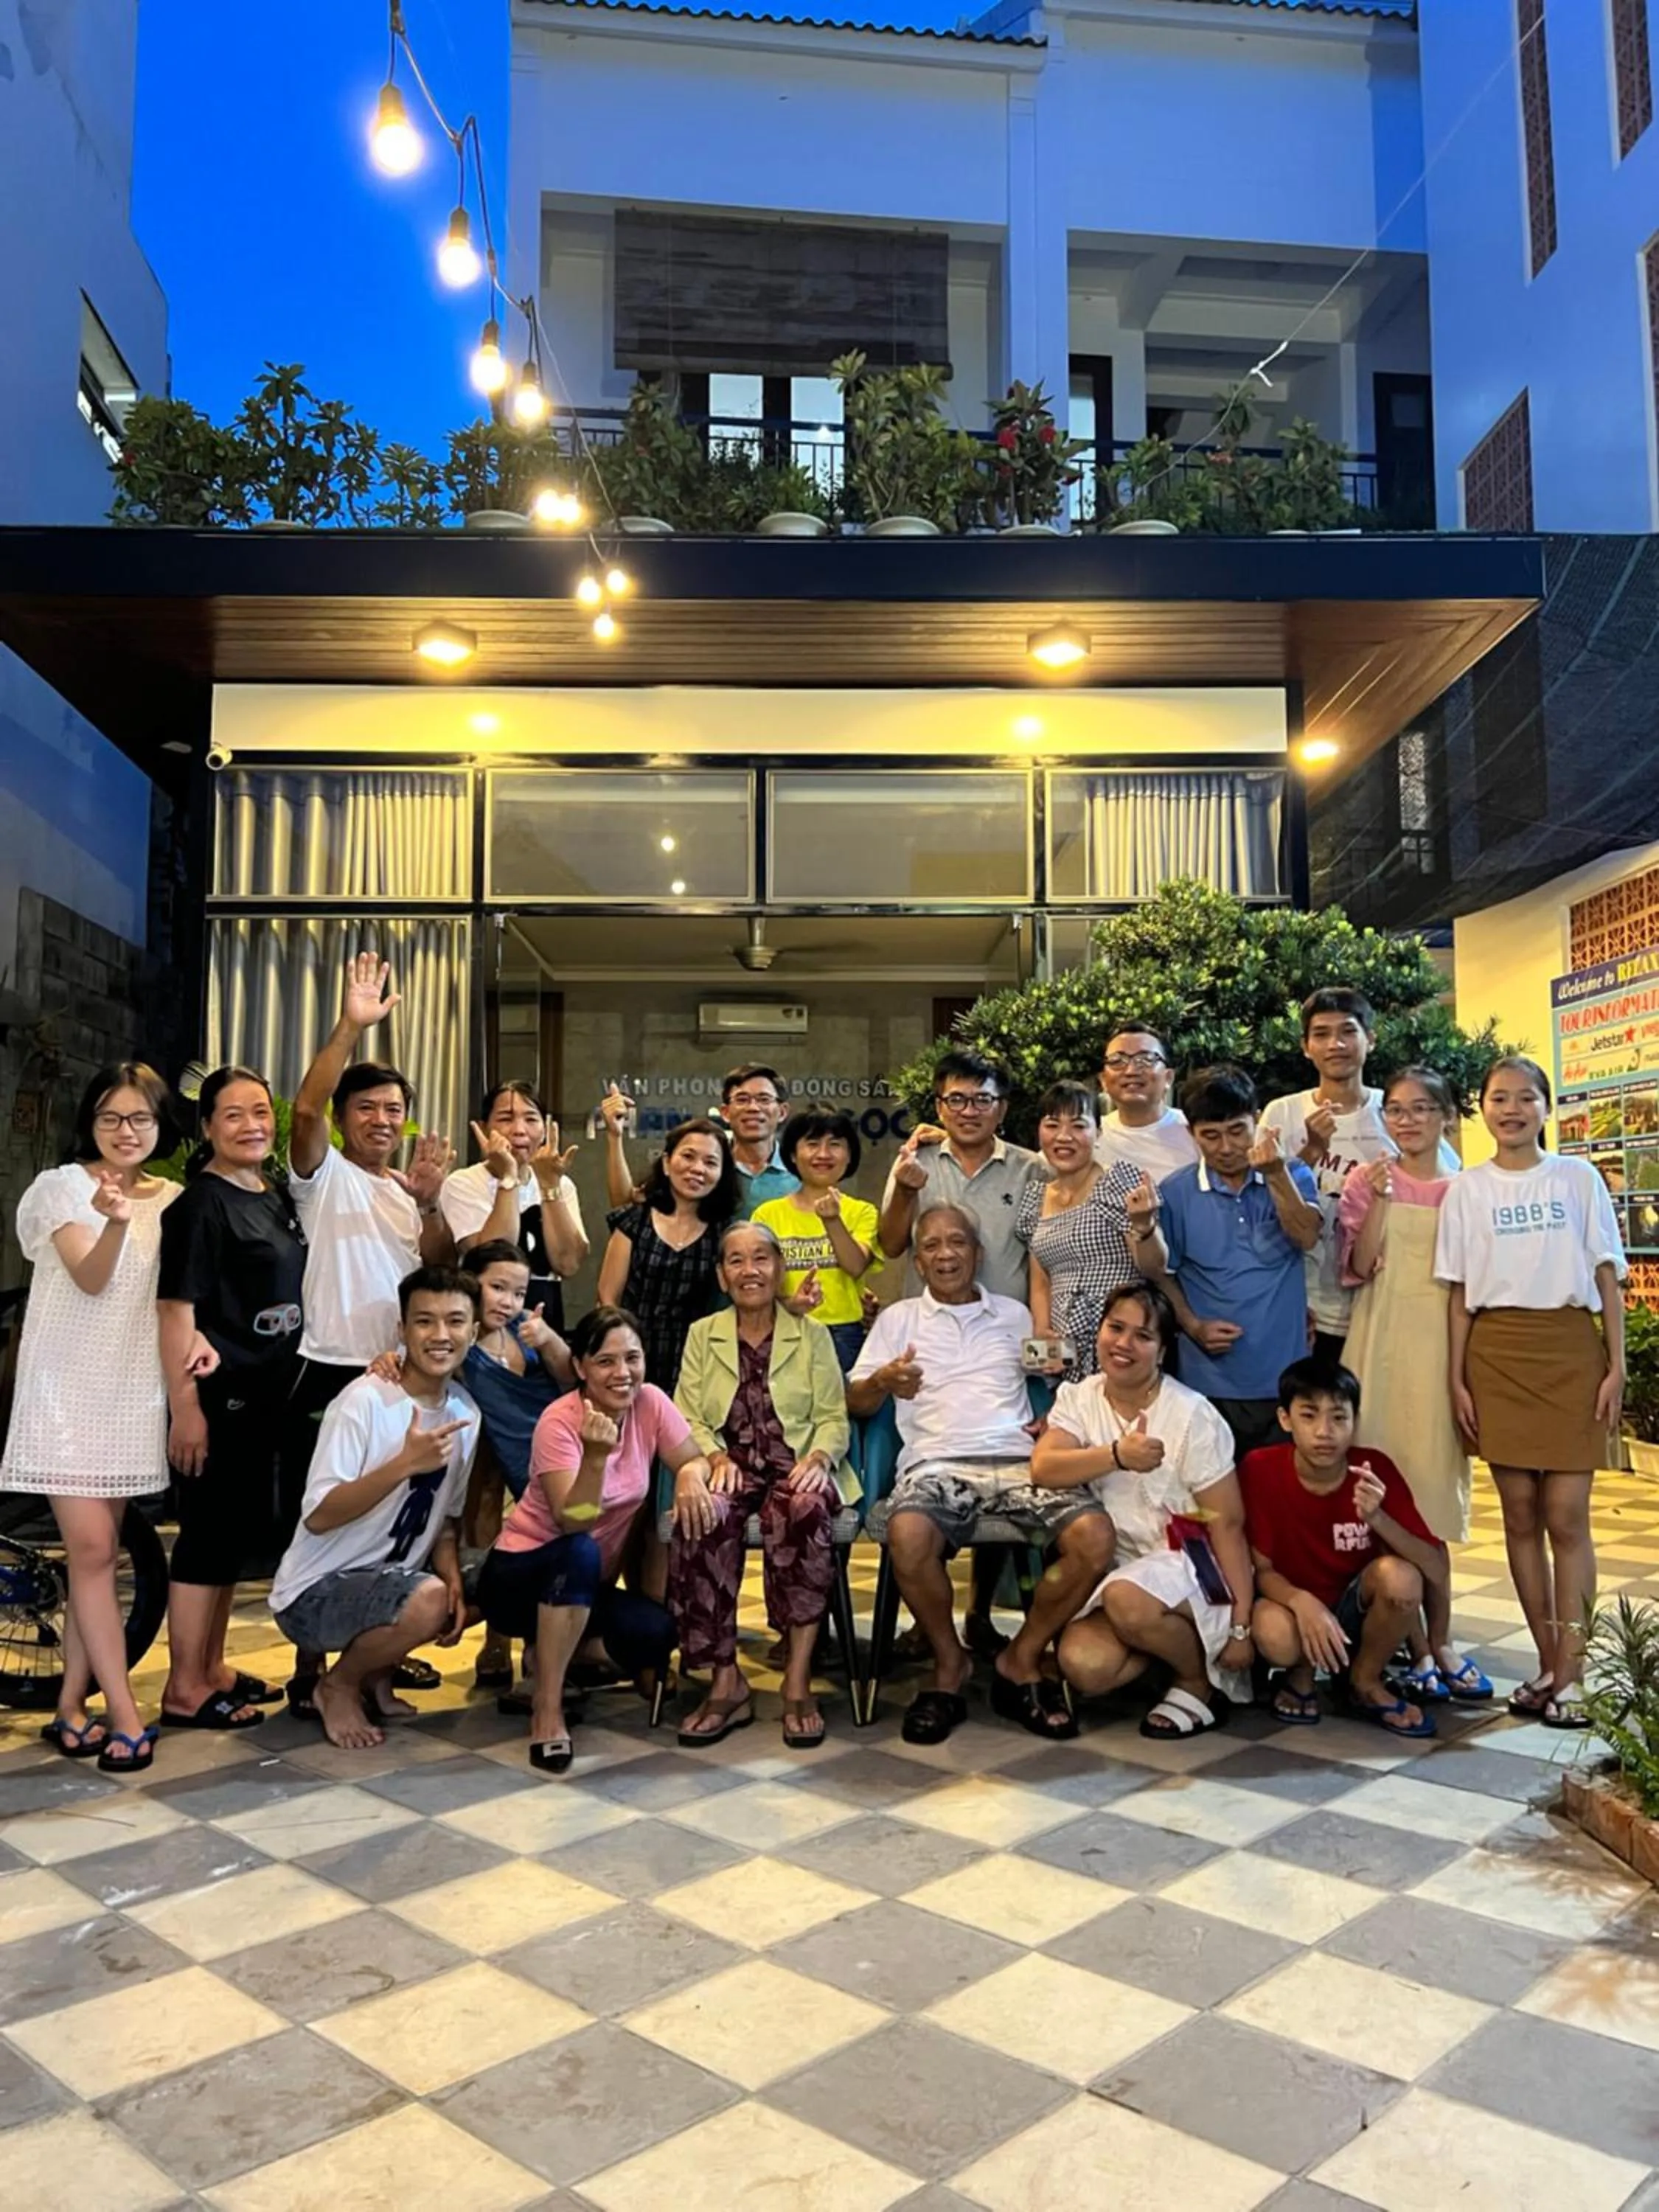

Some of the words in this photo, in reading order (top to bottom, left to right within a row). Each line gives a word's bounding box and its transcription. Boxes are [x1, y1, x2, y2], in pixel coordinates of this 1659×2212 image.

[1604, 970, 1615, 986] to
[1593, 989, 1659, 1026] INFORMAT
[1591, 1032, 1624, 1051] Jetstar
